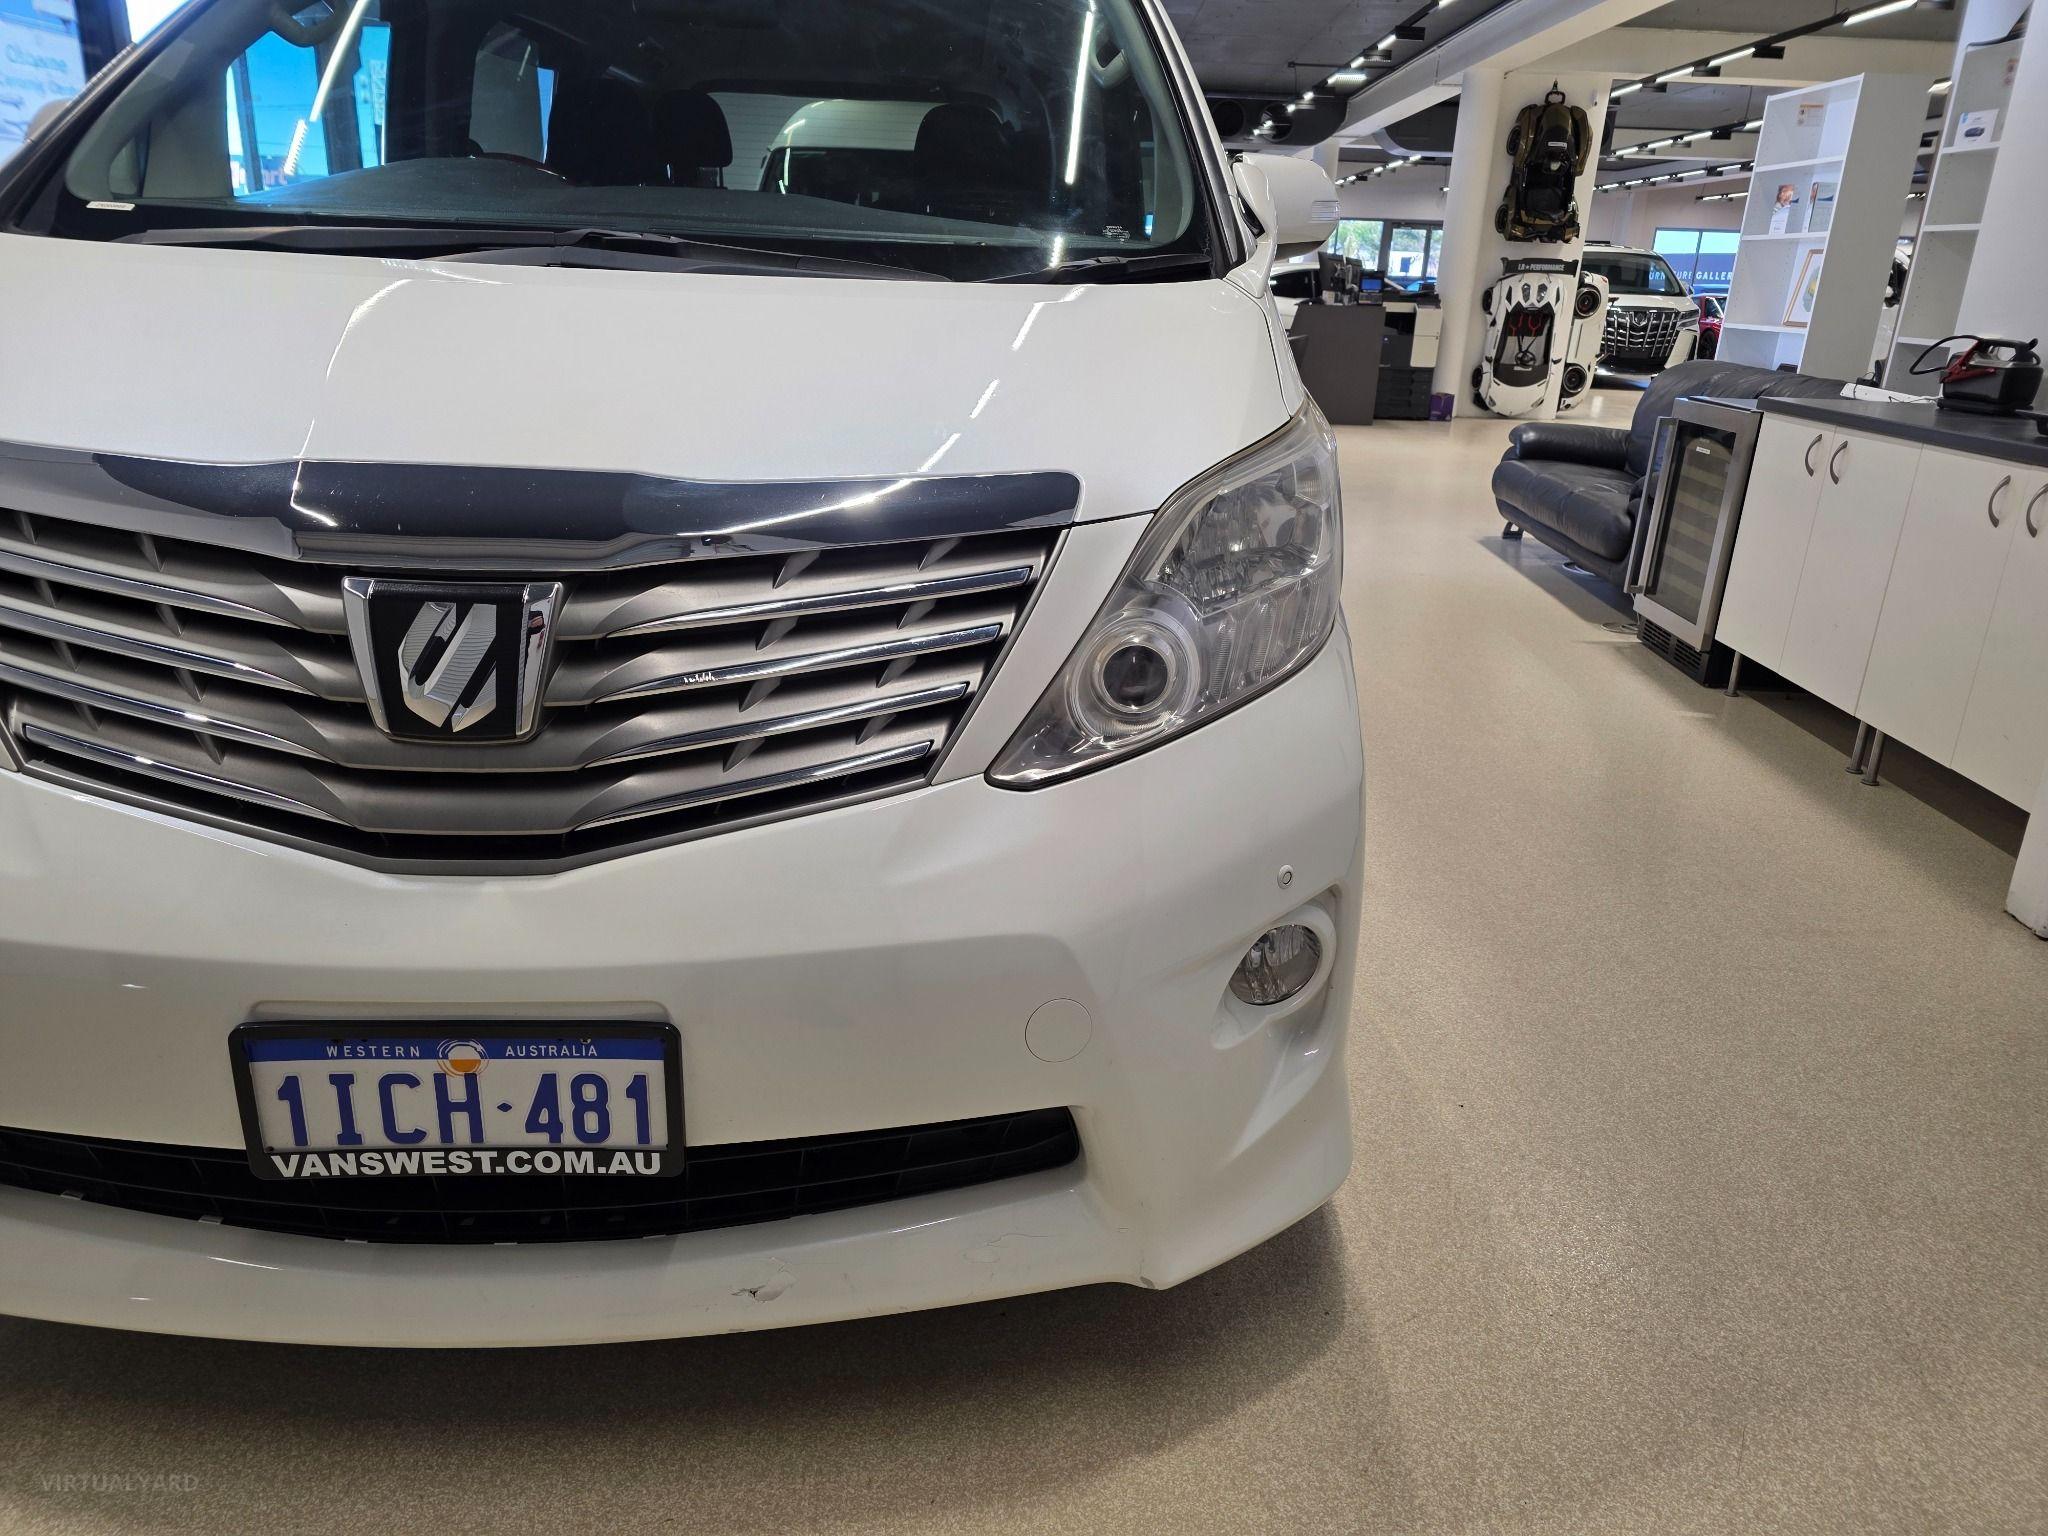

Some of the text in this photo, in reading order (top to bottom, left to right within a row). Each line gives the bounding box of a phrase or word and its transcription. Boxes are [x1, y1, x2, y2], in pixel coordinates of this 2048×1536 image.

[1529, 263, 1566, 271] PERFORMANCE
[1695, 271, 1733, 280] GALLER
[326, 1044, 598, 1058] WESTERN AUSTRALIA
[270, 1150, 661, 1178] VANSWEST.COM.AU
